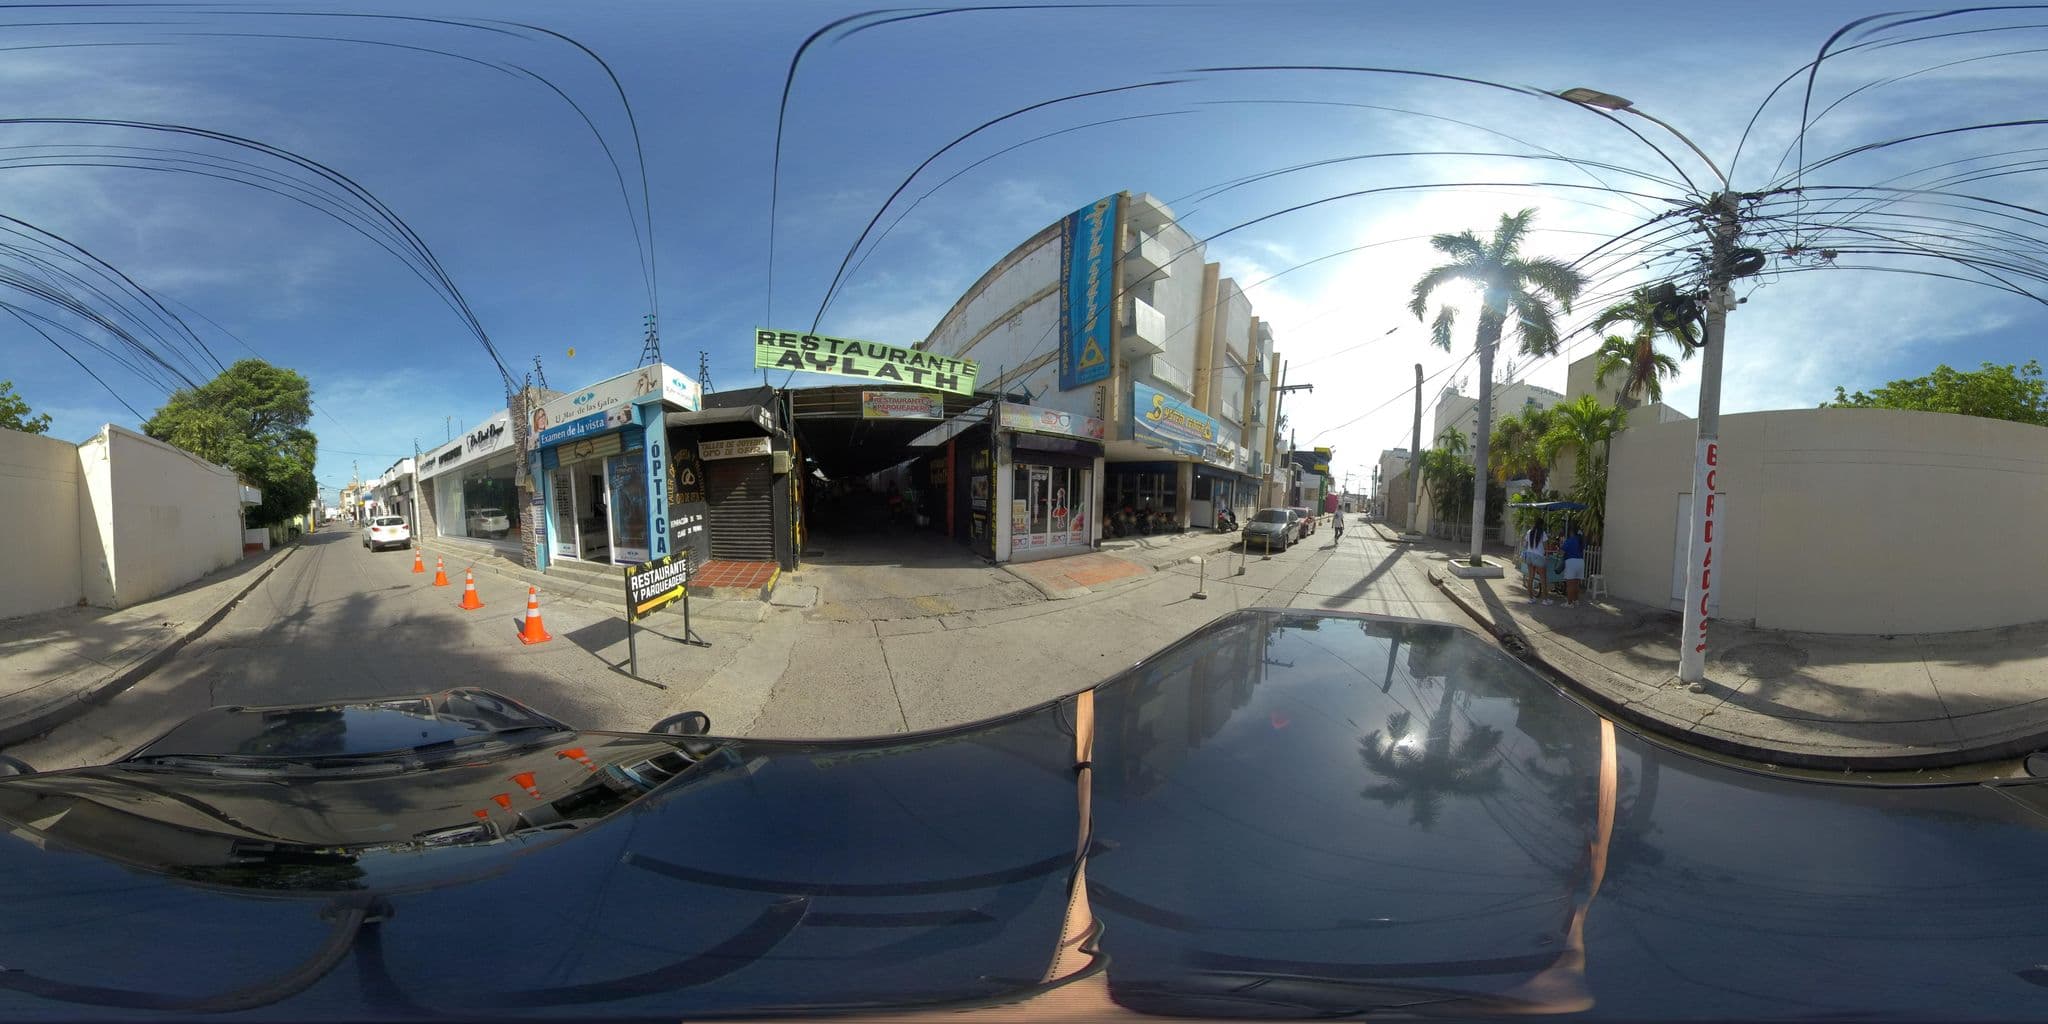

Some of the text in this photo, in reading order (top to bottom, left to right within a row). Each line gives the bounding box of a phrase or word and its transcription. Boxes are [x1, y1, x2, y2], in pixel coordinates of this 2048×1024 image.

[757, 330, 977, 376] RESTAURANTE
[775, 349, 958, 391] AYLATH
[577, 407, 585, 416] de
[586, 402, 597, 412] las
[597, 396, 619, 410] Gafas
[541, 420, 605, 445] Examen de la vista
[700, 441, 724, 450] TALLER
[651, 440, 667, 554] ÓPTICA
[631, 559, 687, 591] RESTAURANTE
[632, 571, 687, 603] Y PARQUEADERO
